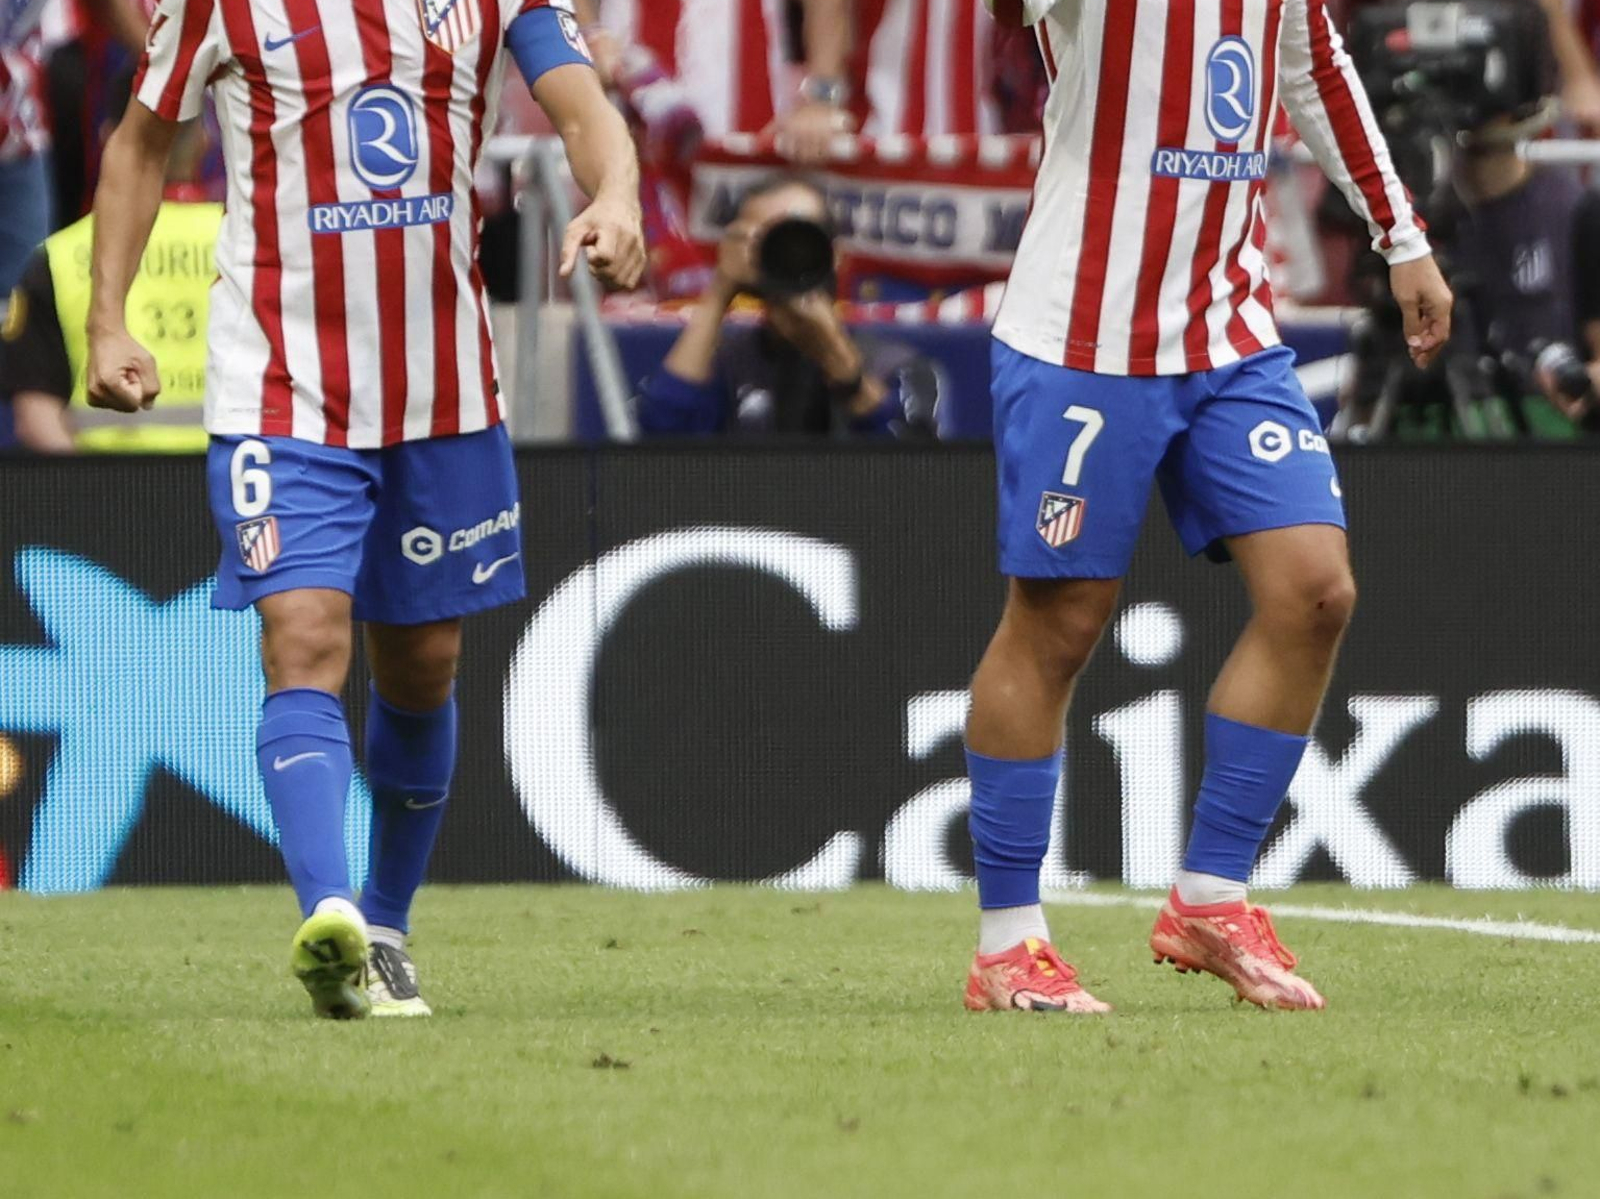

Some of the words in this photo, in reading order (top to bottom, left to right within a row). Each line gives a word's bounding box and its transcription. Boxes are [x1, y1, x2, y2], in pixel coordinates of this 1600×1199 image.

[1155, 150, 1240, 177] RIYADH
[314, 201, 413, 231] RIYADH
[418, 195, 449, 221] AIR
[1062, 405, 1105, 486] 7
[231, 439, 271, 517] 6
